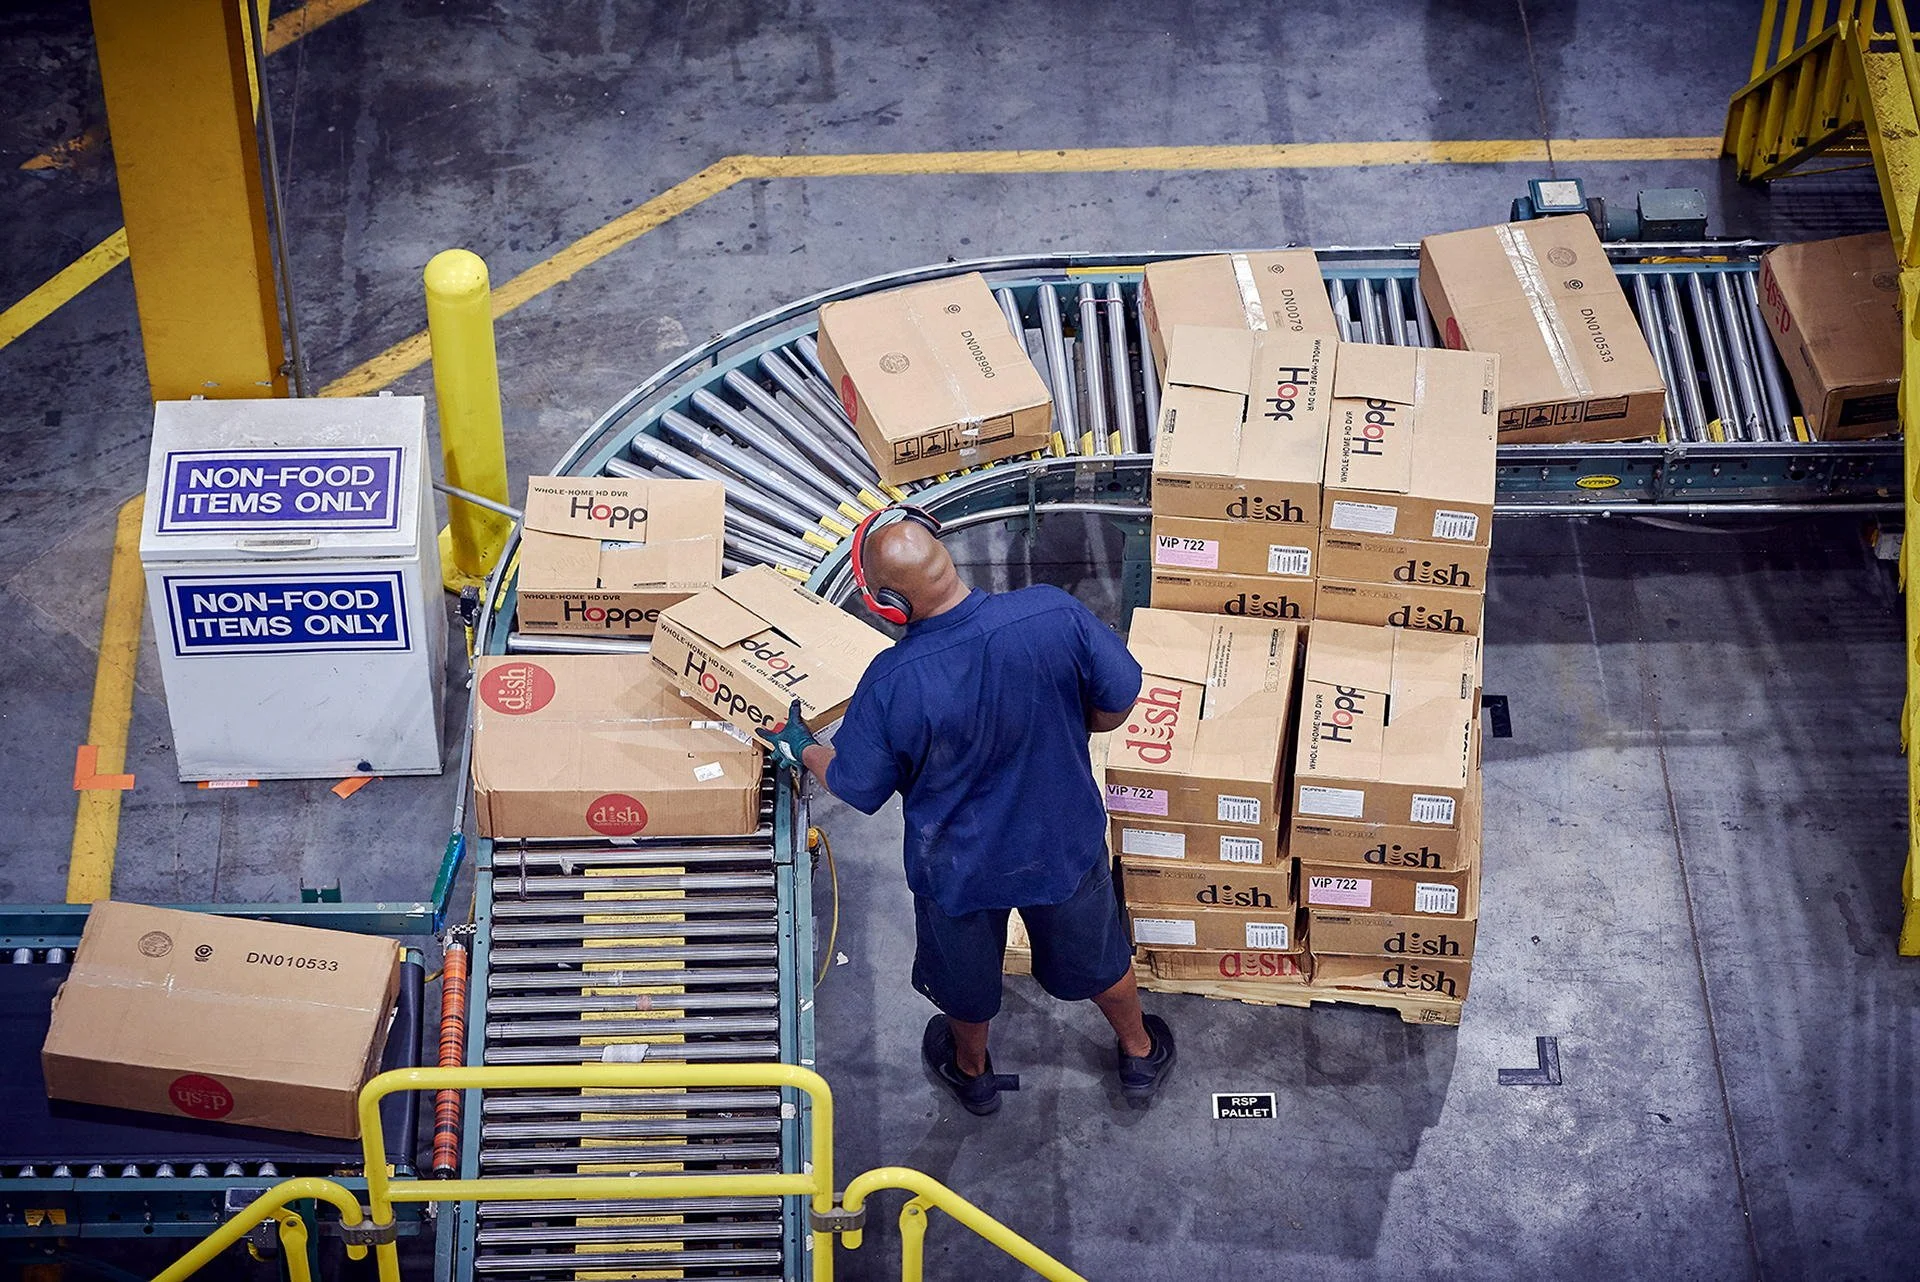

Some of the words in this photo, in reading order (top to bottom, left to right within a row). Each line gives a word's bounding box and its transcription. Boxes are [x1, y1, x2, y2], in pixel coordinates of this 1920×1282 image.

[1581, 308, 1614, 363] DN010533
[961, 330, 996, 379] DN008990
[1310, 339, 1322, 386] WHOLE-HOME
[1340, 437, 1352, 482] WHOLE-HOME
[189, 465, 375, 489] NON-FOOD
[178, 492, 282, 514] ITEMS
[295, 490, 381, 512] ONLY
[534, 486, 594, 496] WHOLE-HOME
[610, 490, 628, 498] DVR
[1226, 496, 1307, 523] dish
[1159, 536, 1180, 548] ViP
[1183, 539, 1204, 552] 722
[1393, 560, 1473, 588] dish
[193, 589, 379, 614] NON-FOOD
[1224, 594, 1303, 619] dish
[188, 616, 292, 638] ITEMS
[304, 613, 389, 634] ONLY
[1388, 606, 1467, 633] dish
[660, 623, 708, 660] WHOLE-HOME
[708, 658, 719, 668] HD
[720, 663, 735, 679] DVR
[498, 667, 527, 710] dish
[1126, 687, 1183, 764] dish
[1309, 721, 1320, 770] WHOLE-HOME
[1108, 785, 1128, 796] ViP
[1132, 788, 1154, 800] 722
[592, 806, 641, 823] dish
[1364, 844, 1442, 869] dish
[1196, 885, 1274, 908] dish
[1311, 878, 1332, 890] ViP
[1336, 879, 1358, 890] 722
[1384, 932, 1460, 956] dish
[246, 952, 339, 972] DN010533
[1383, 964, 1458, 998] dish
[176, 1090, 227, 1110] dish
[1232, 1097, 1258, 1106] RSP
[1221, 1108, 1269, 1118] PALLET
